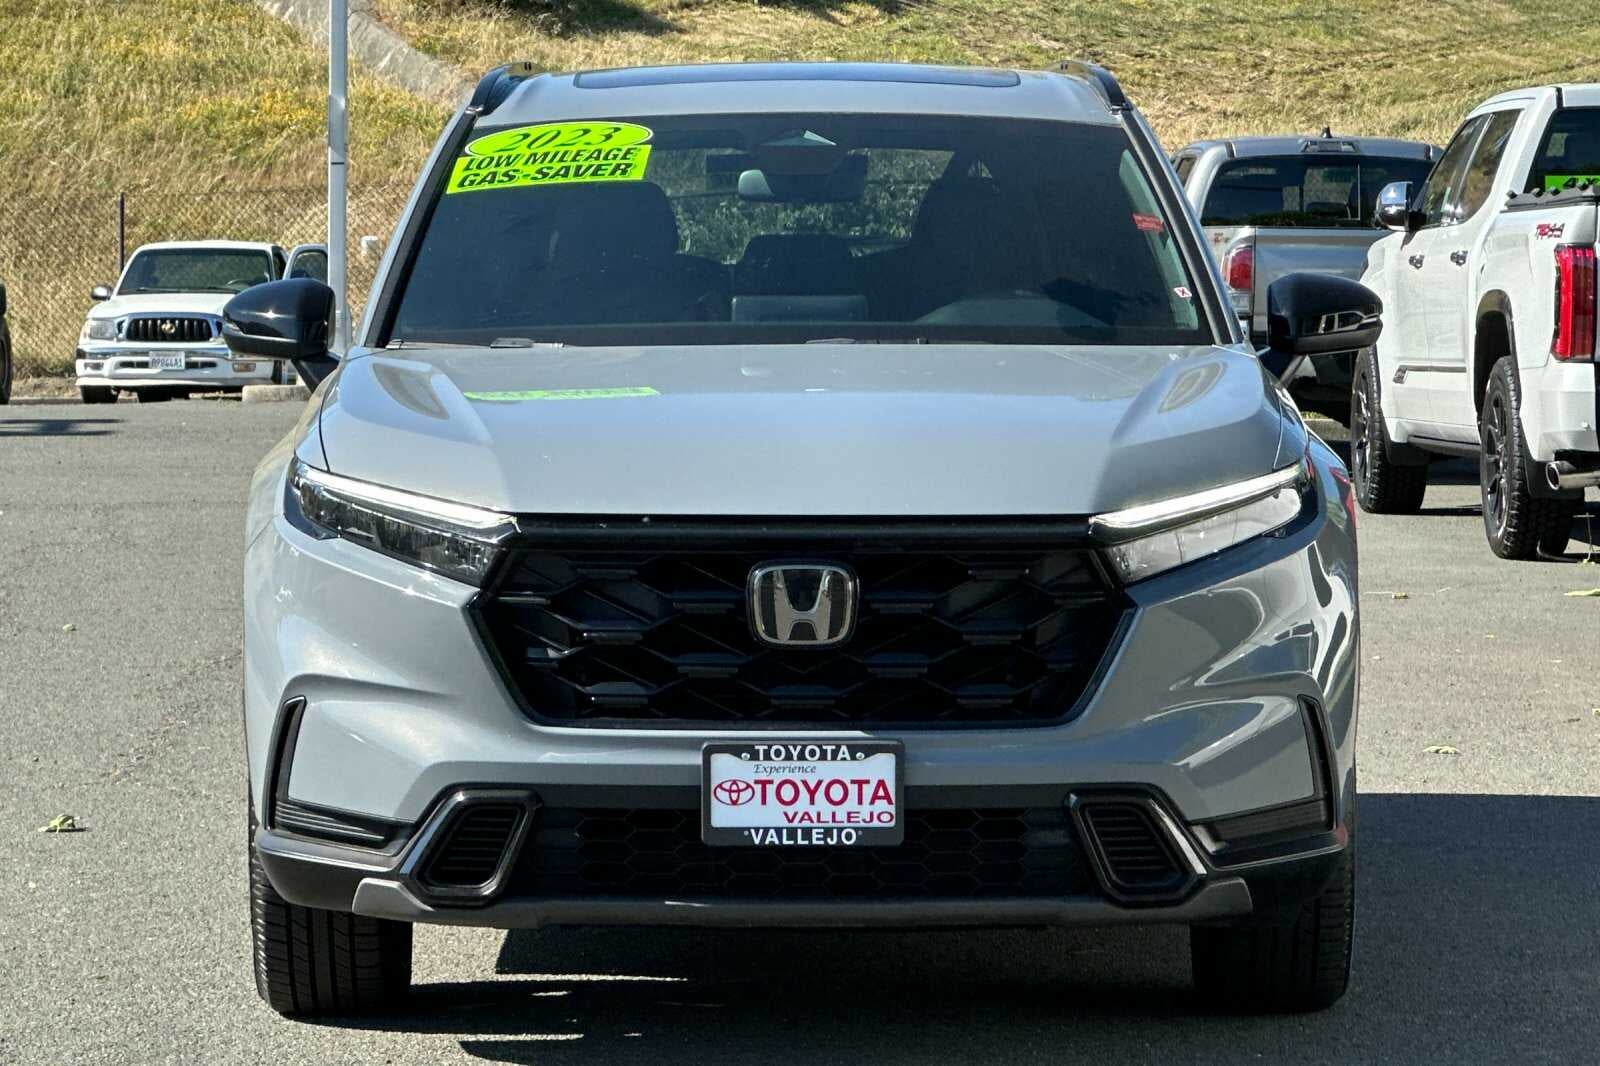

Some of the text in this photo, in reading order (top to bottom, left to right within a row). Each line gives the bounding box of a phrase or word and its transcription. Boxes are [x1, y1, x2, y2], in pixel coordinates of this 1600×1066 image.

[494, 126, 622, 152] 2023
[462, 147, 638, 172] LOW MILEAGE
[457, 162, 635, 188] GAS-SAVER
[755, 745, 850, 761] TOYOTA
[754, 764, 817, 776] Experience
[754, 779, 894, 806] TOYOTA
[783, 811, 895, 824] VALLEJO
[750, 828, 857, 845] VALLEJO
